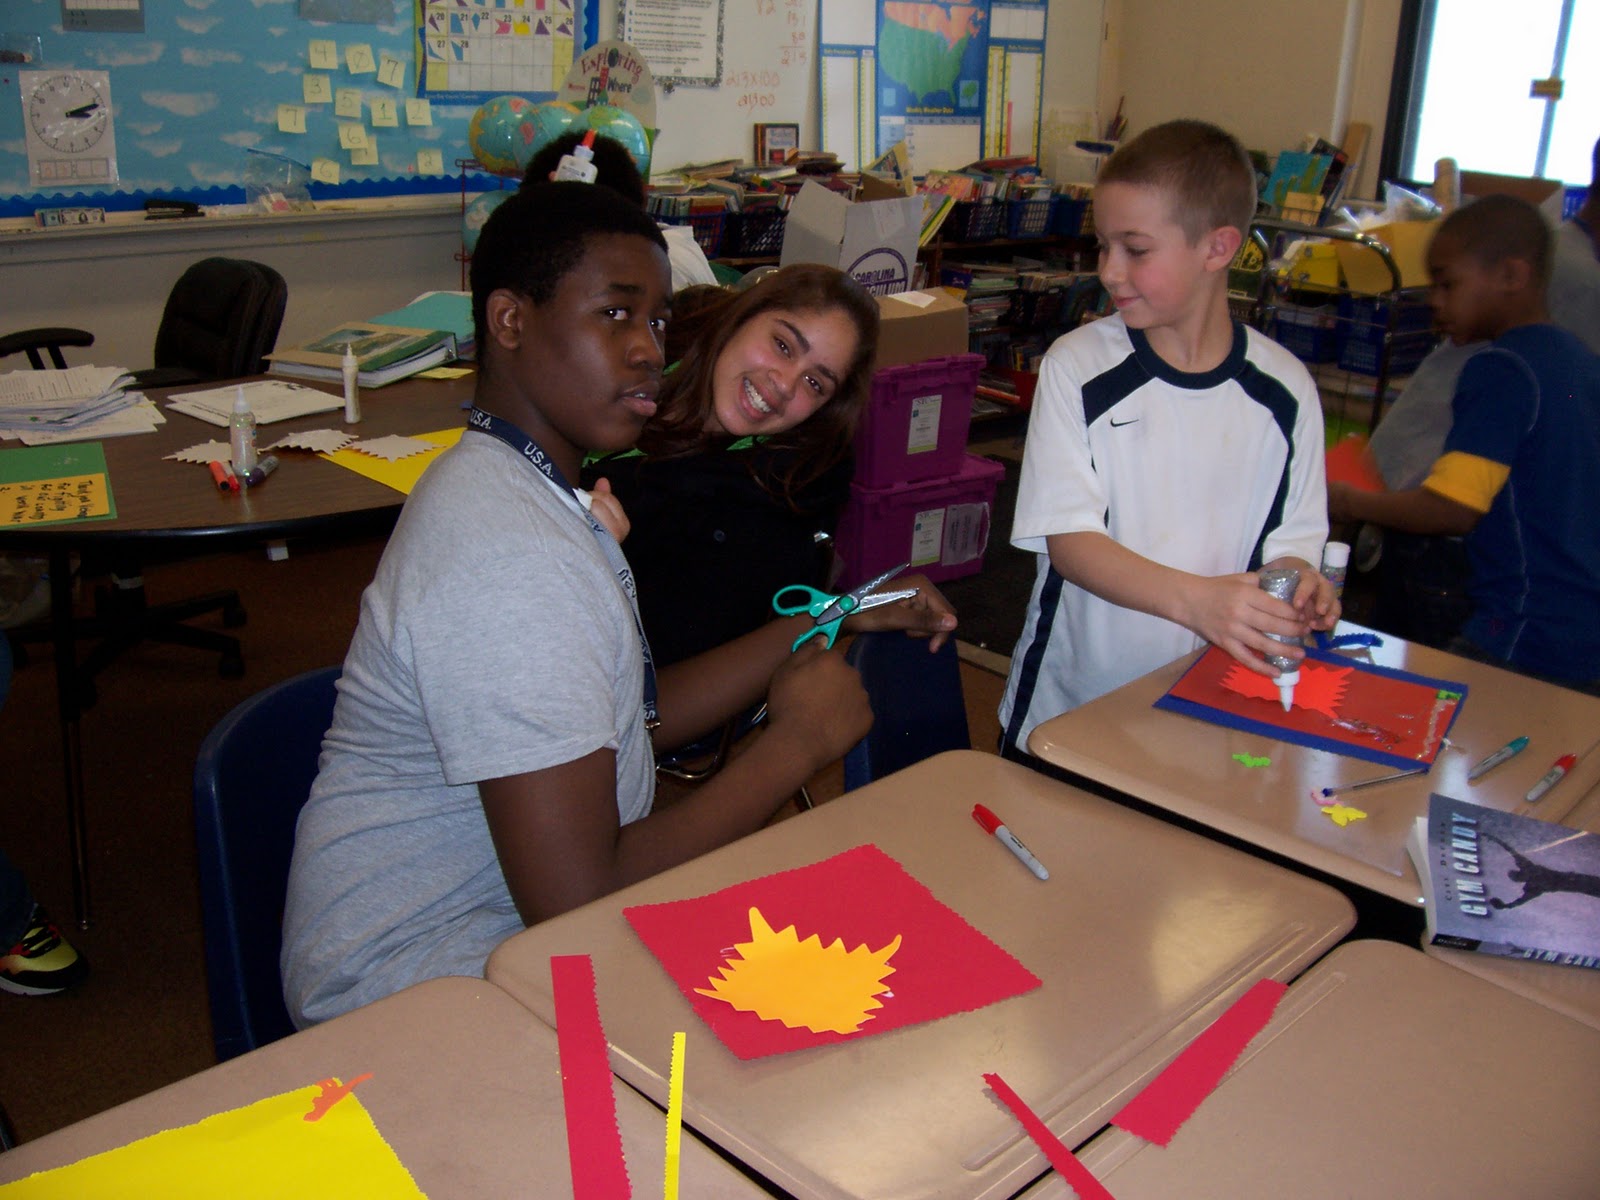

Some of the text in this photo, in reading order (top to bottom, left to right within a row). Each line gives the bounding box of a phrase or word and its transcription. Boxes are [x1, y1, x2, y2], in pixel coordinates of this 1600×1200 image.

[436, 12, 574, 26] 20 21 22 23 24 25 26
[437, 40, 446, 48] 27
[310, 76, 322, 95] 3
[608, 76, 632, 93] Where
[340, 90, 354, 108] 5
[346, 127, 362, 145] 6
[855, 268, 896, 284] CAROLINA
[524, 441, 554, 478] U.S.A.
[1452, 812, 1488, 916] GYM CANDY
[1523, 948, 1559, 962] GYM
